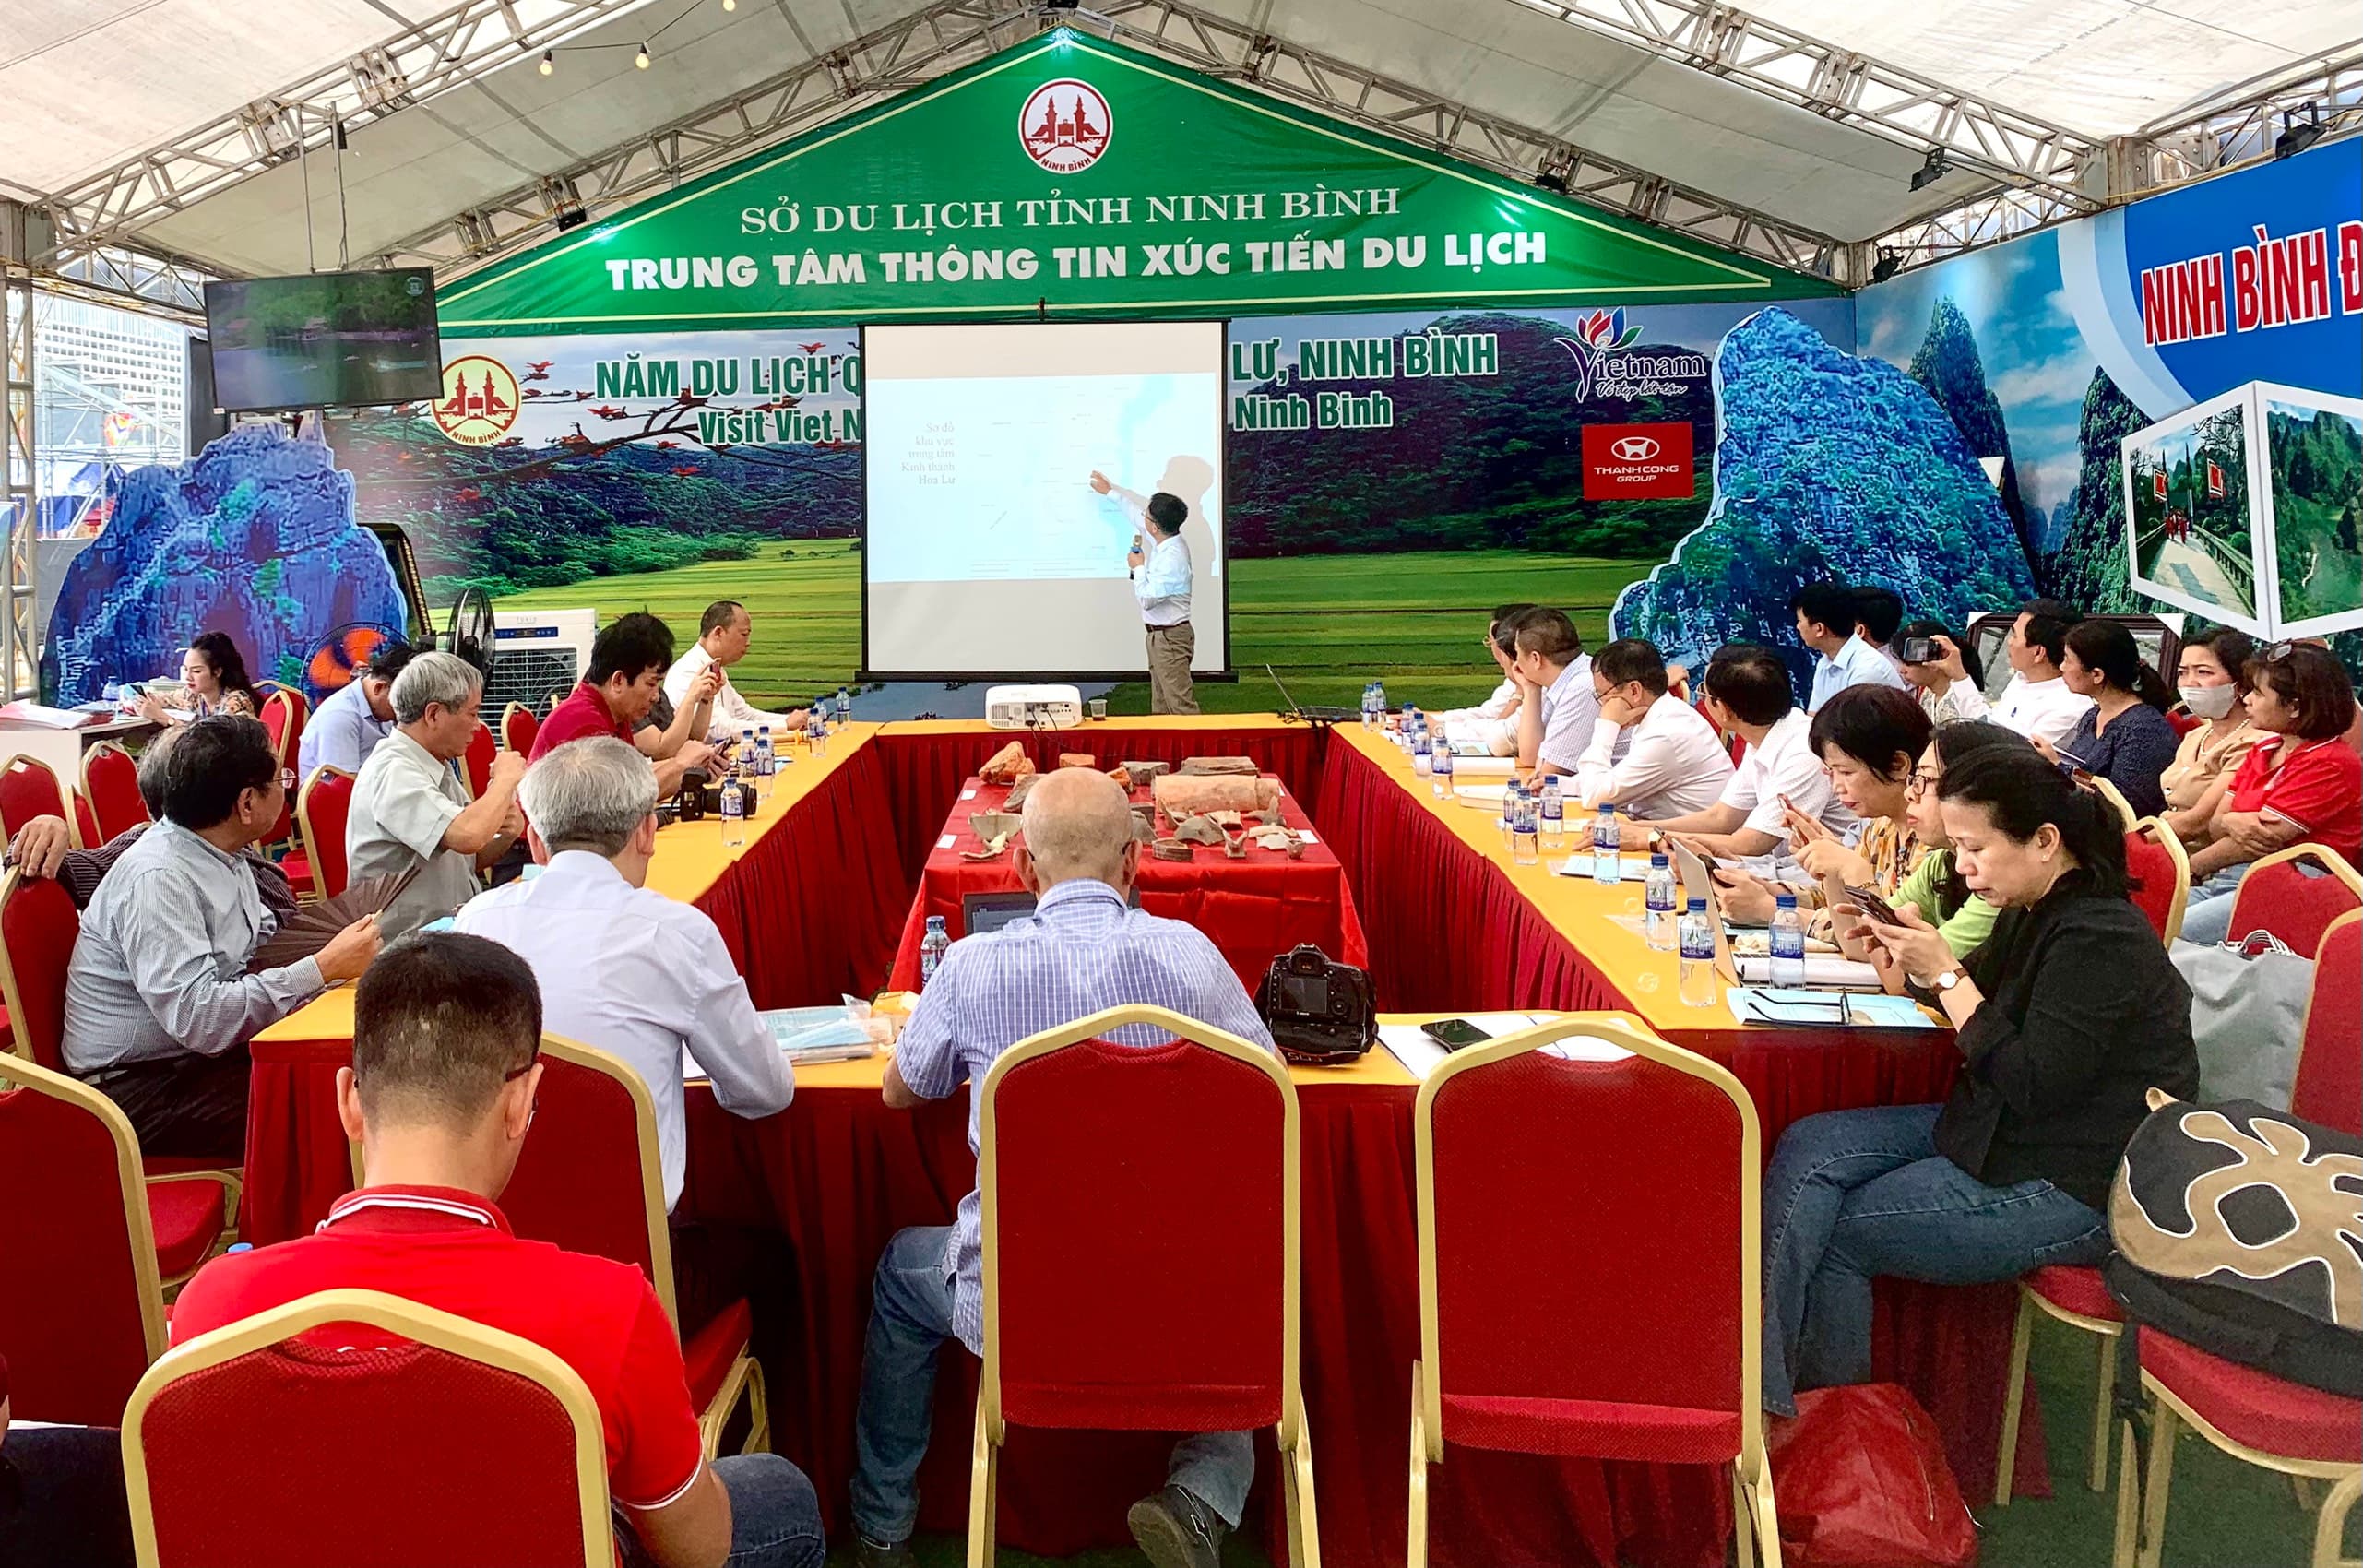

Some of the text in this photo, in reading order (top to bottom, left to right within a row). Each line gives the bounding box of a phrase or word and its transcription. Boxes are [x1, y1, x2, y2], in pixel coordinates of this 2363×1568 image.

[1041, 158, 1066, 172] NINH
[741, 183, 1401, 236] SỞ DU LỊCH TỈNH NINH BÌNH
[605, 229, 1546, 291] TRUNG TÂM THÔNG TIN XÚC TIẾN DU LỊCH
[2142, 252, 2227, 348] NINH
[2232, 223, 2332, 333] BÌNH
[595, 351, 681, 398] NĂM
[691, 358, 740, 397] DU
[751, 355, 831, 403] LỊCH
[1300, 338, 1395, 380] NINH
[1404, 327, 1499, 376] BÌNH
[1554, 338, 1706, 404] Vietnam
[452, 431, 476, 444] NINH
[697, 410, 766, 444] Visit
[774, 409, 833, 443] Viet
[1234, 394, 1309, 431] Ninh
[1317, 391, 1394, 428] Binh
[919, 474, 939, 485] Hoa
